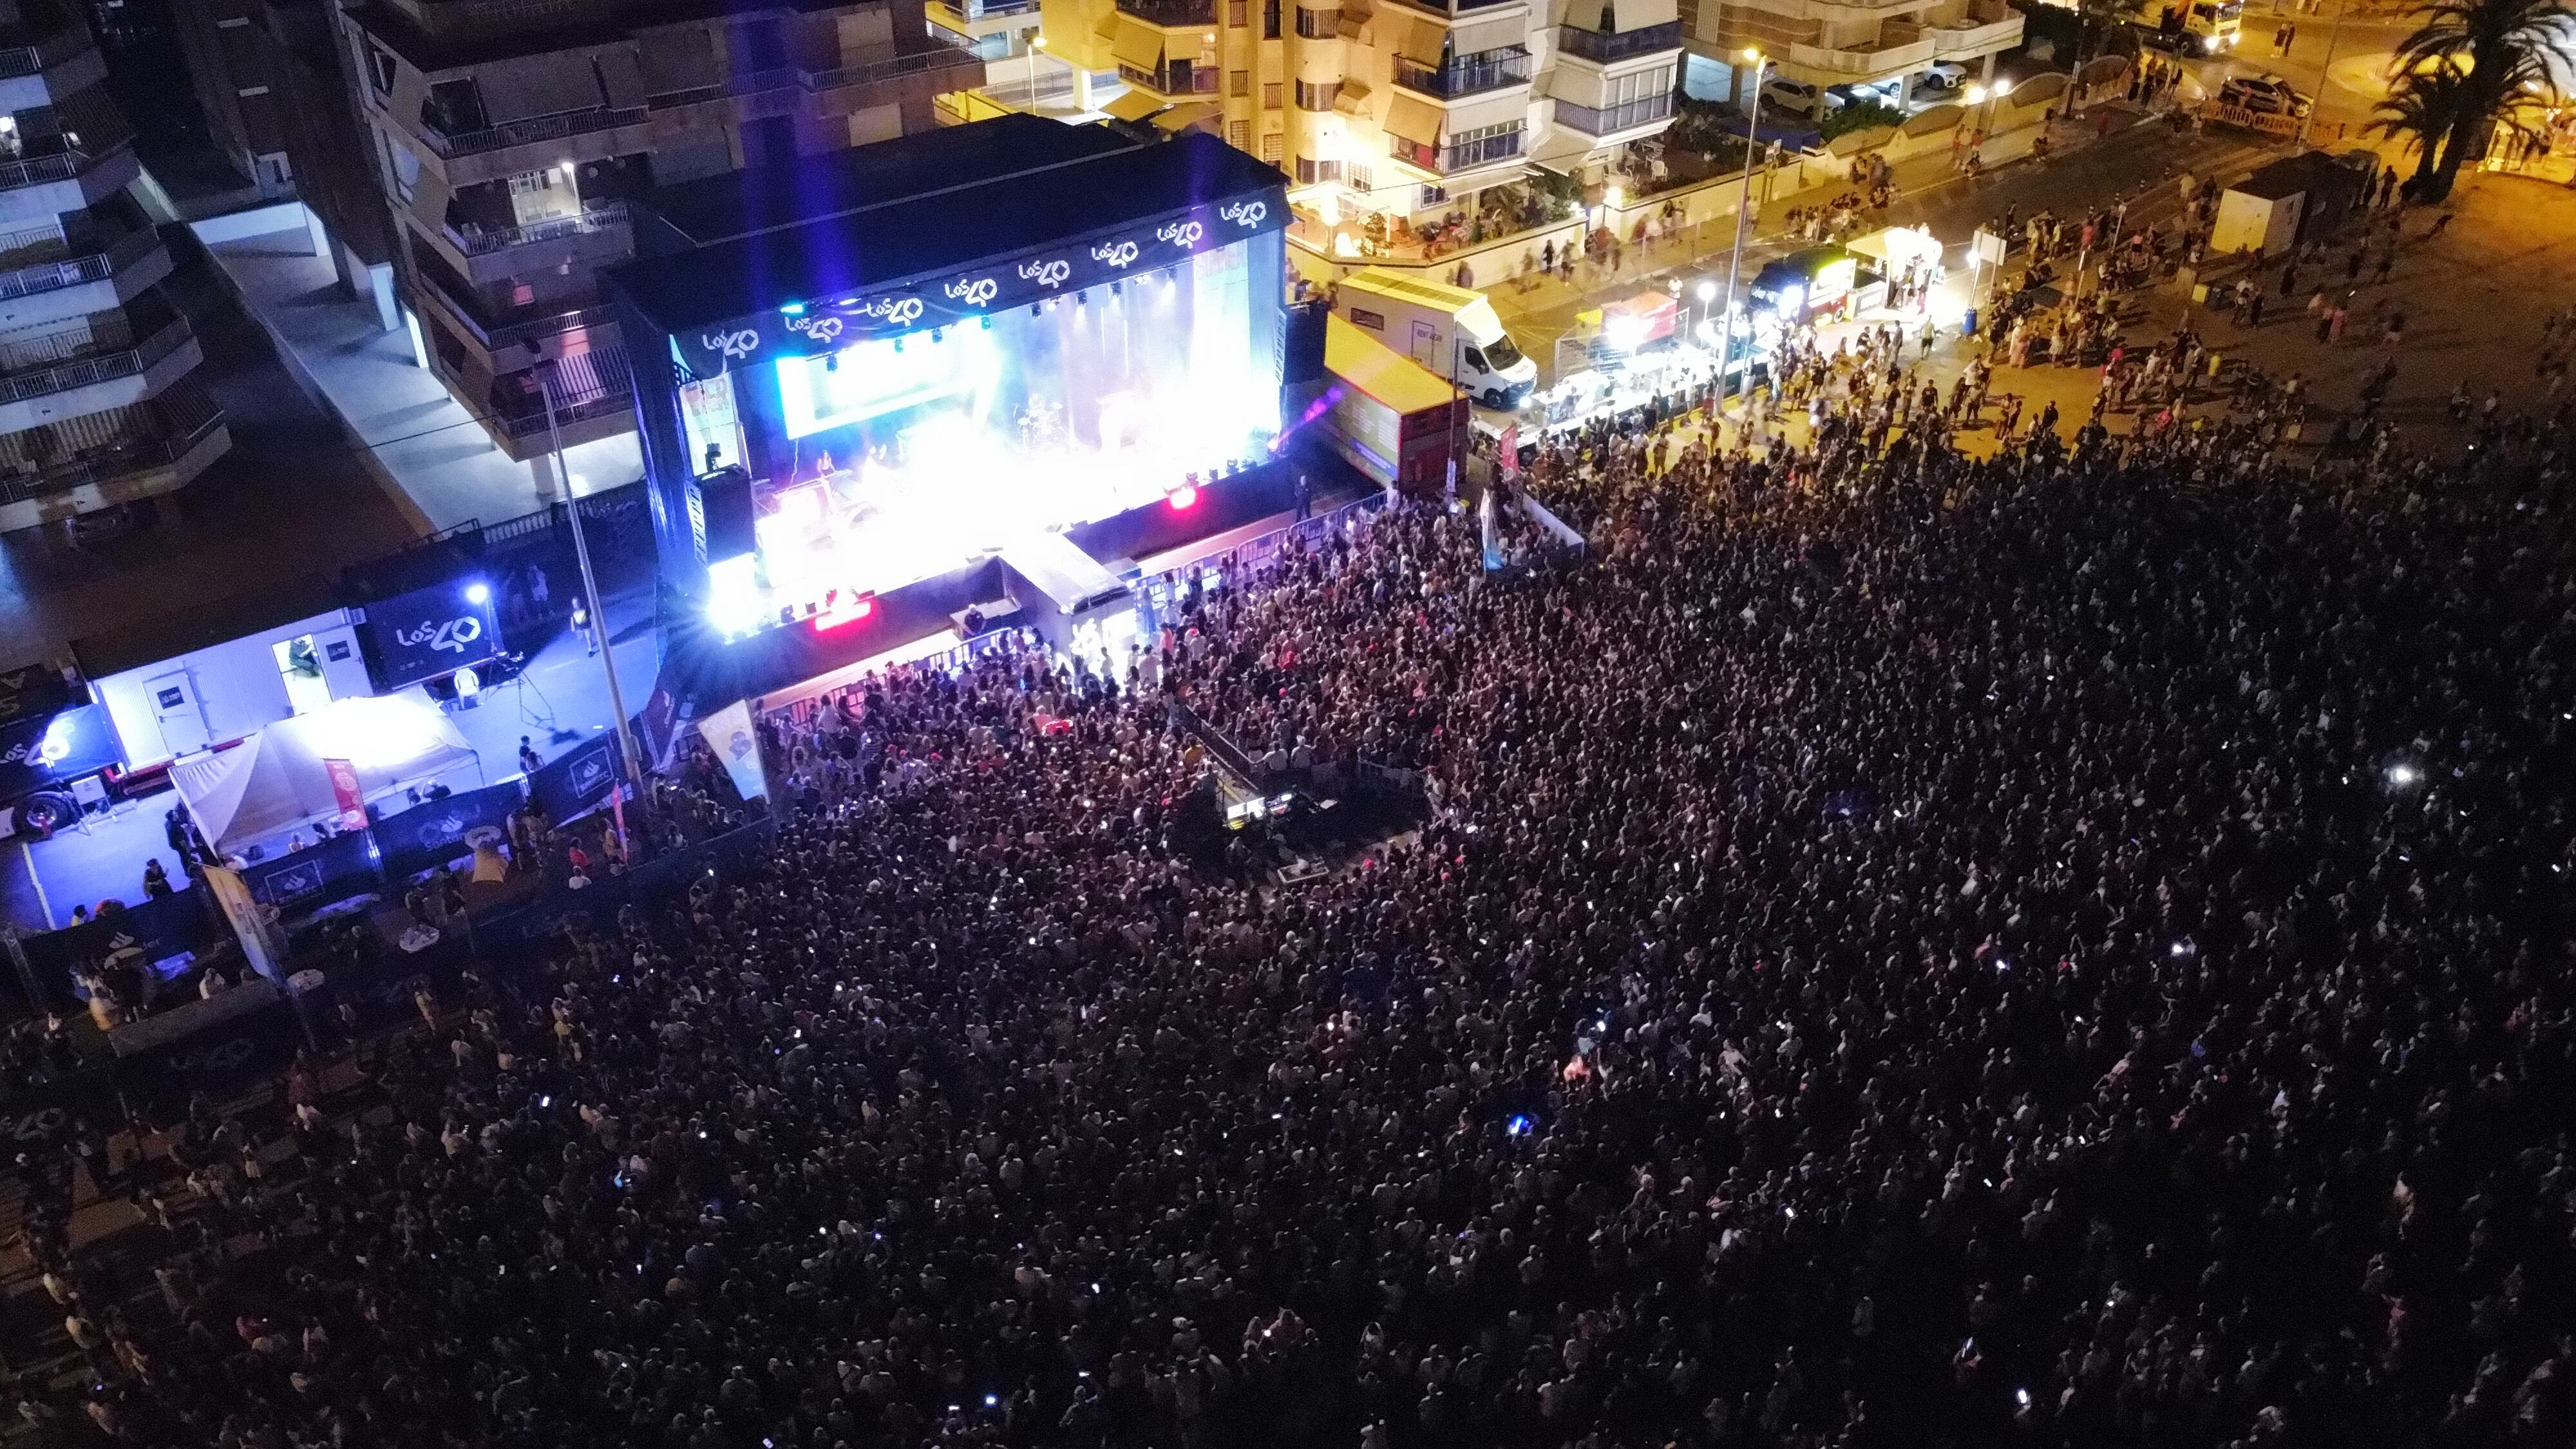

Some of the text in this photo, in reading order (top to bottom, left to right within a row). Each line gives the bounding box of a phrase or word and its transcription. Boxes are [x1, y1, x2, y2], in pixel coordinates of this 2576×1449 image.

[1238, 201, 1267, 229] 40
[1174, 221, 1203, 249] 40
[1108, 241, 1139, 269] 40
[1037, 260, 1070, 289] 40
[964, 278, 998, 307] 40
[887, 298, 923, 327] 40
[723, 329, 759, 359] 40
[807, 317, 843, 343] 40
[430, 616, 482, 653] 40
